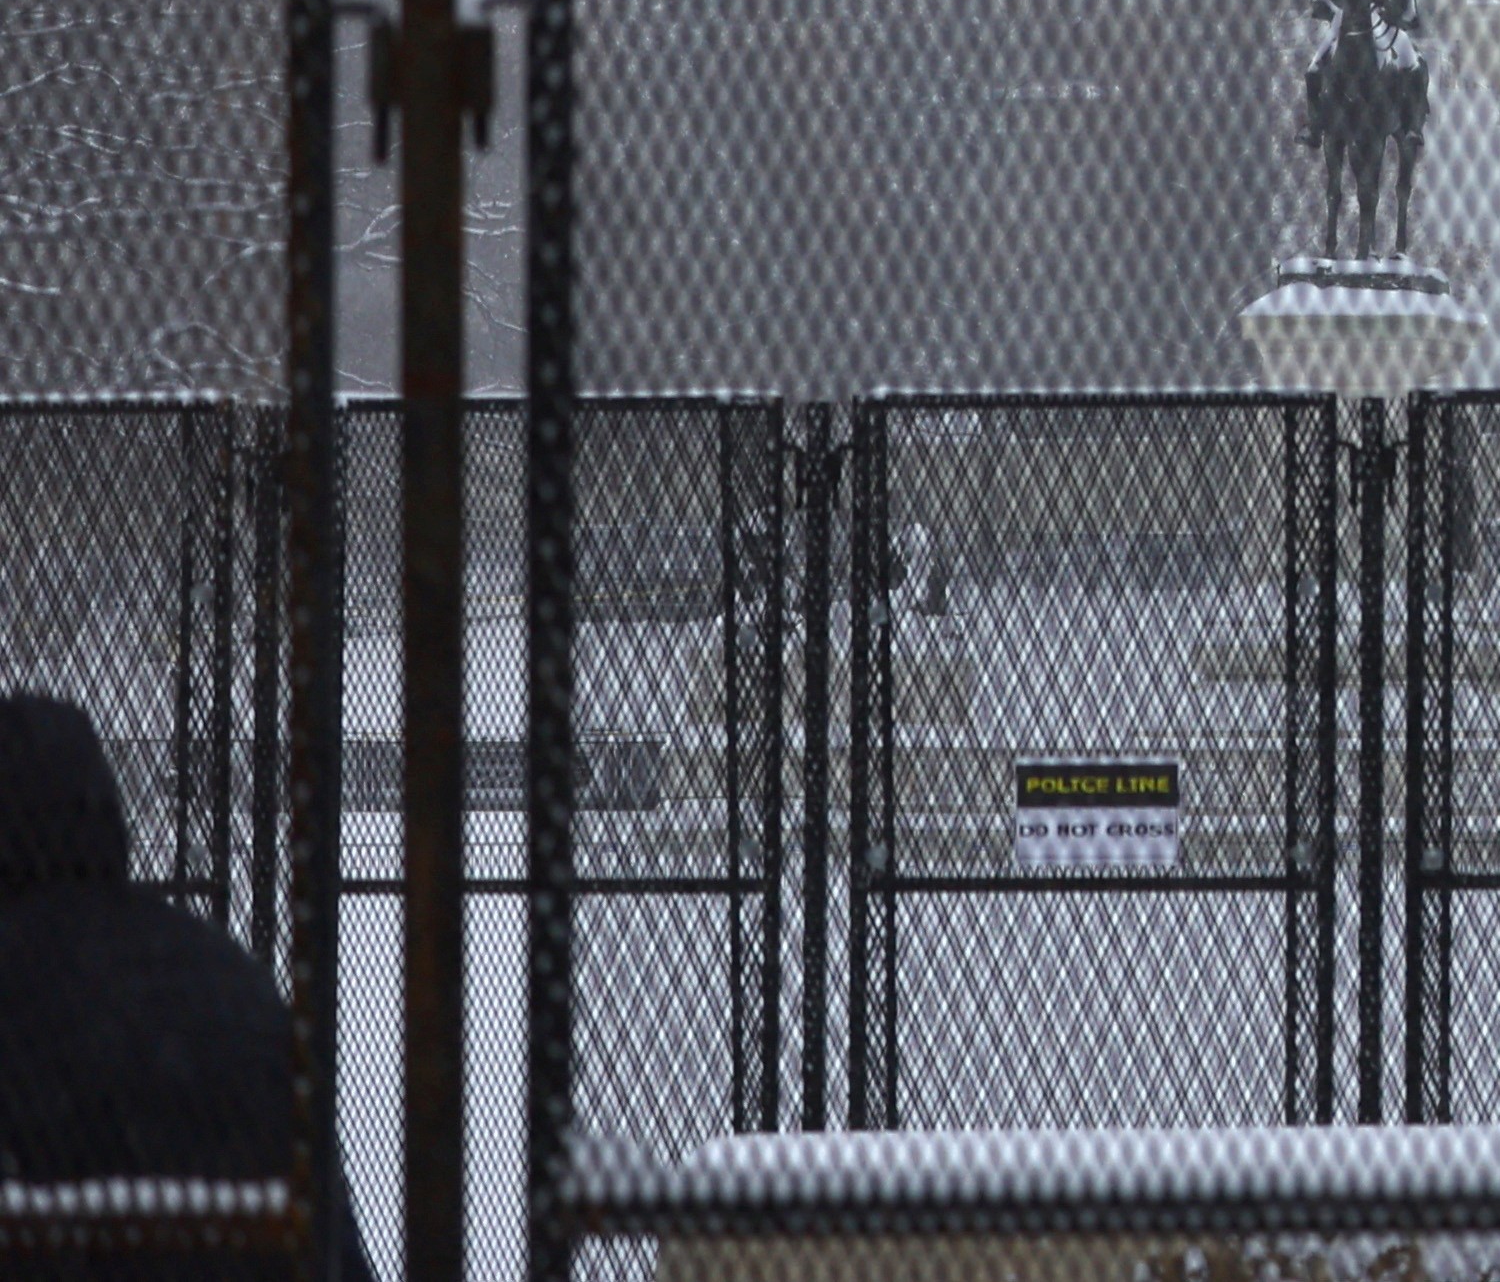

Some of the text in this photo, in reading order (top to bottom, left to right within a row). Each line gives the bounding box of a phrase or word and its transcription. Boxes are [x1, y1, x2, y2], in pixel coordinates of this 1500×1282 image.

[1026, 776, 1169, 794] POLICE LINE
[1019, 823, 1174, 838] DO NOT CROSS
